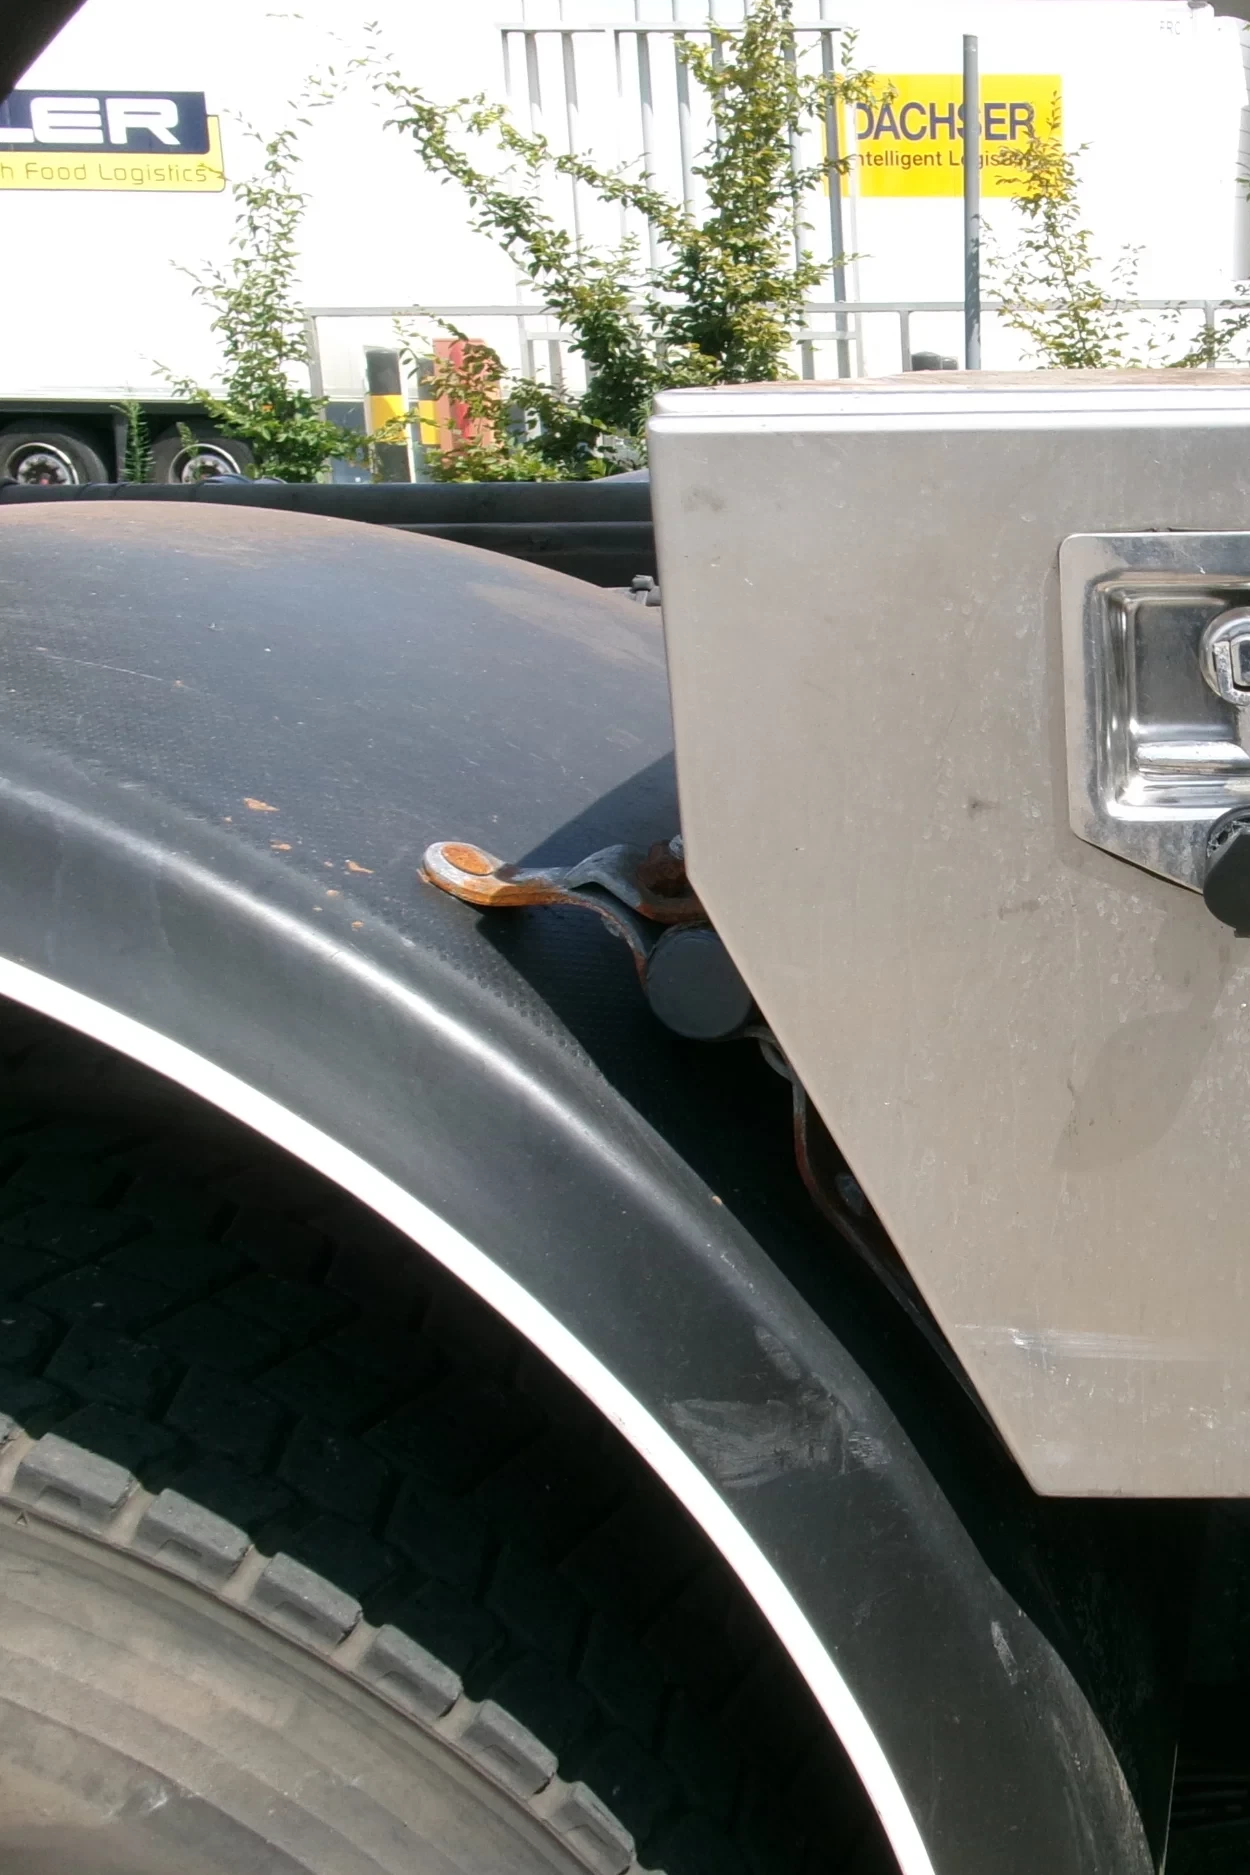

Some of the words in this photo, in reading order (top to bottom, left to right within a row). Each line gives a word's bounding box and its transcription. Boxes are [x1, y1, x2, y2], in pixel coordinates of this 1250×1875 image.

[857, 150, 943, 170] ntelligent
[25, 162, 86, 180] Food
[98, 163, 207, 185] Logistics
